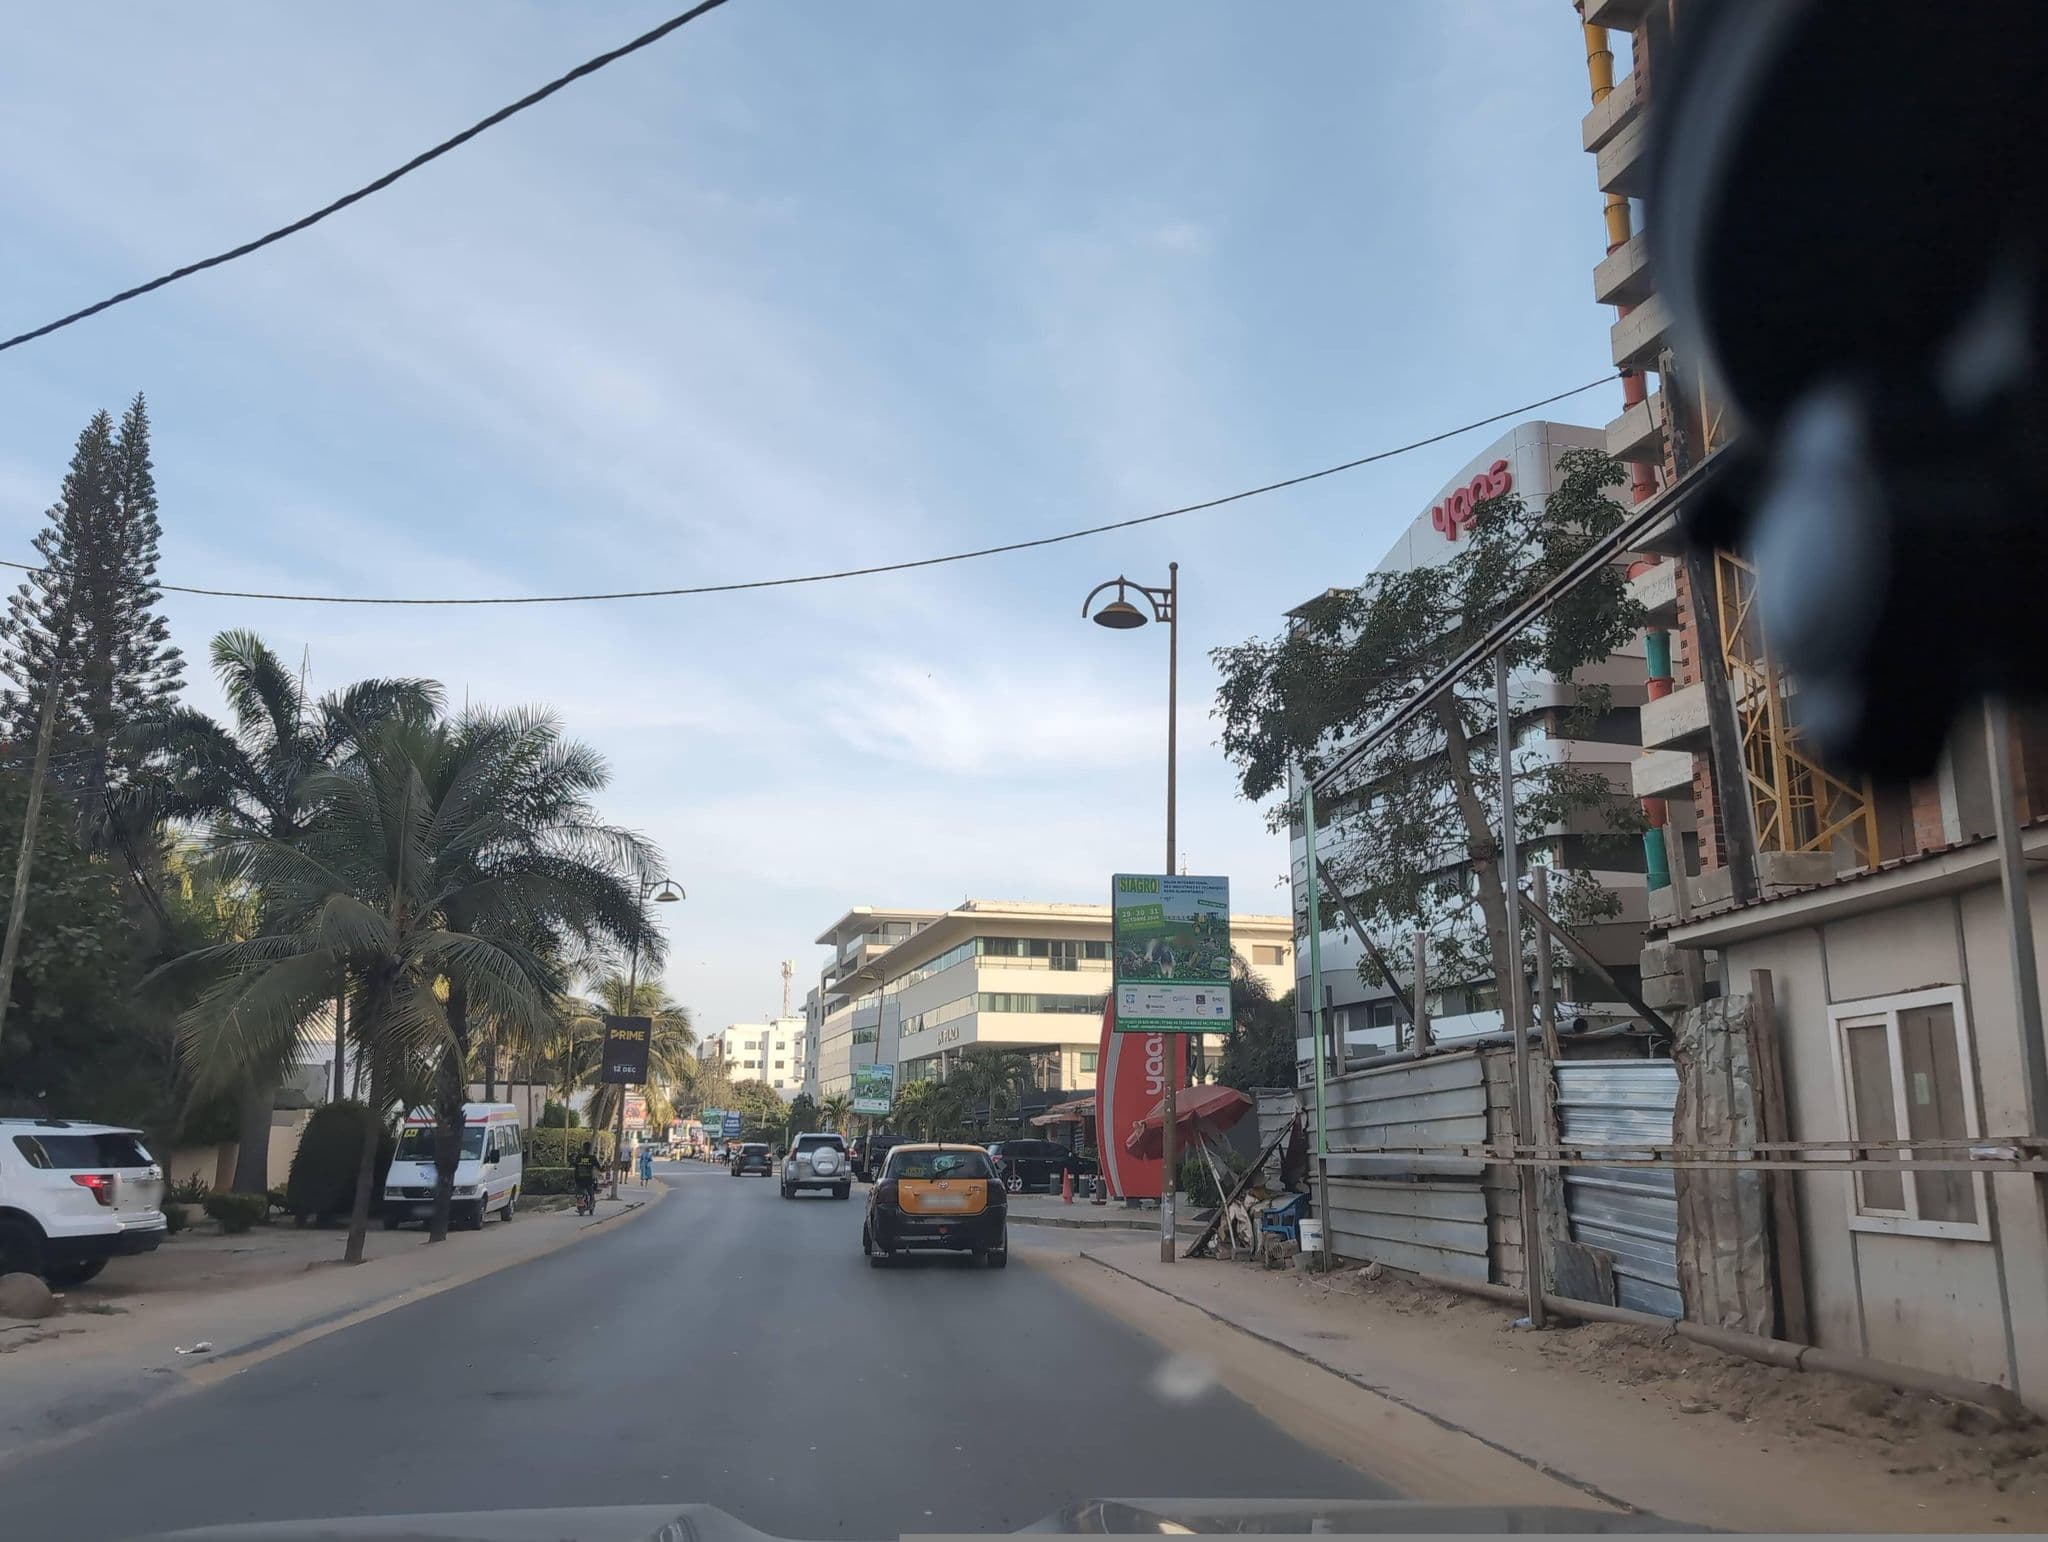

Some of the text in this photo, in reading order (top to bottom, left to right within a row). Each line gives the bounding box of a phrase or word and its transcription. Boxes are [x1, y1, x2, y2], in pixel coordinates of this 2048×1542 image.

[1432, 459, 1512, 541] yaas
[610, 1029, 645, 1041] PRIME
[1144, 1033, 1167, 1096] yaa
